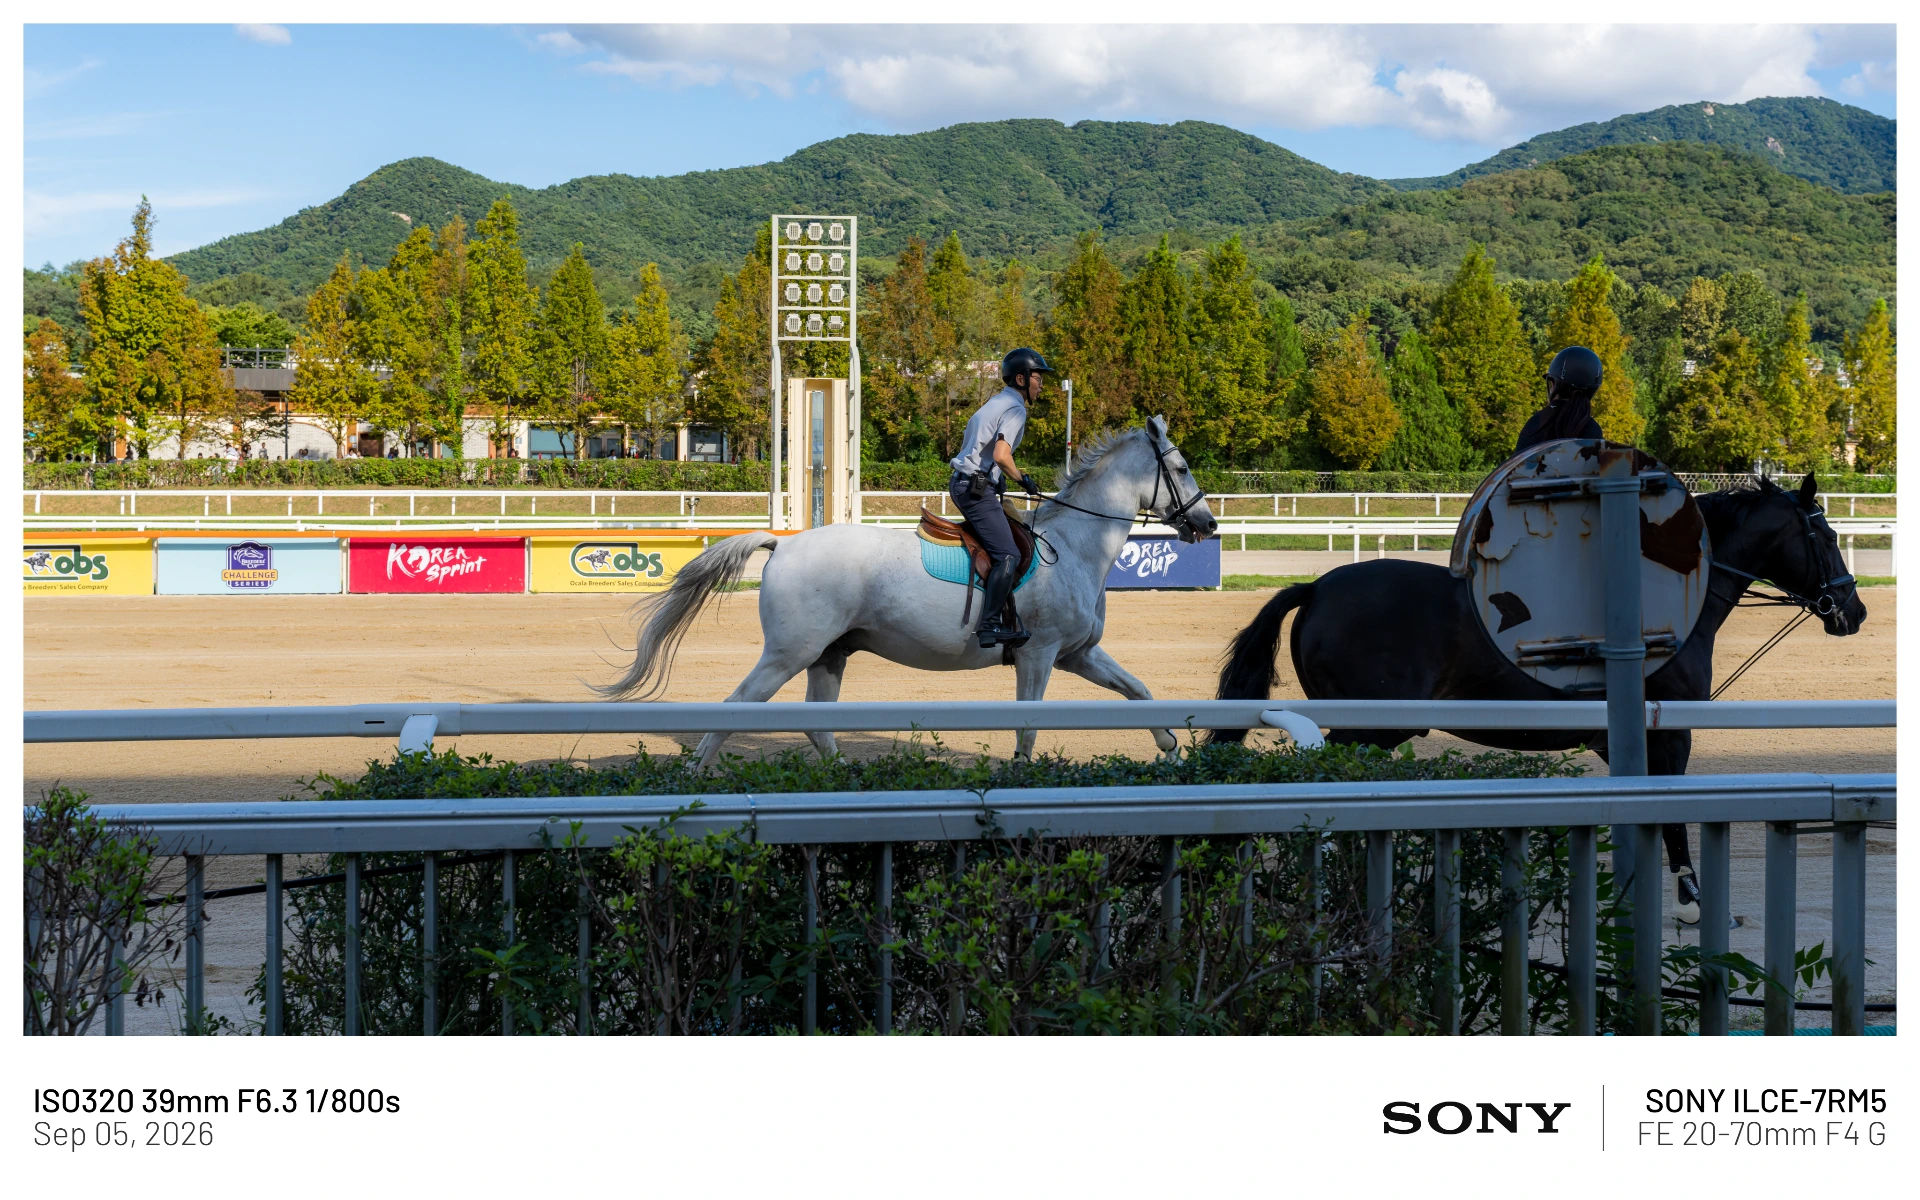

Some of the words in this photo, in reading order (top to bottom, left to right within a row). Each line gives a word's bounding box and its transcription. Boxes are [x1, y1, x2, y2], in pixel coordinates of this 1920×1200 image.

[54, 545, 109, 581] obs
[223, 571, 276, 579] CHALLENGE
[425, 555, 488, 585] Sprint
[613, 542, 664, 578] obs
[1136, 552, 1179, 578] CUP
